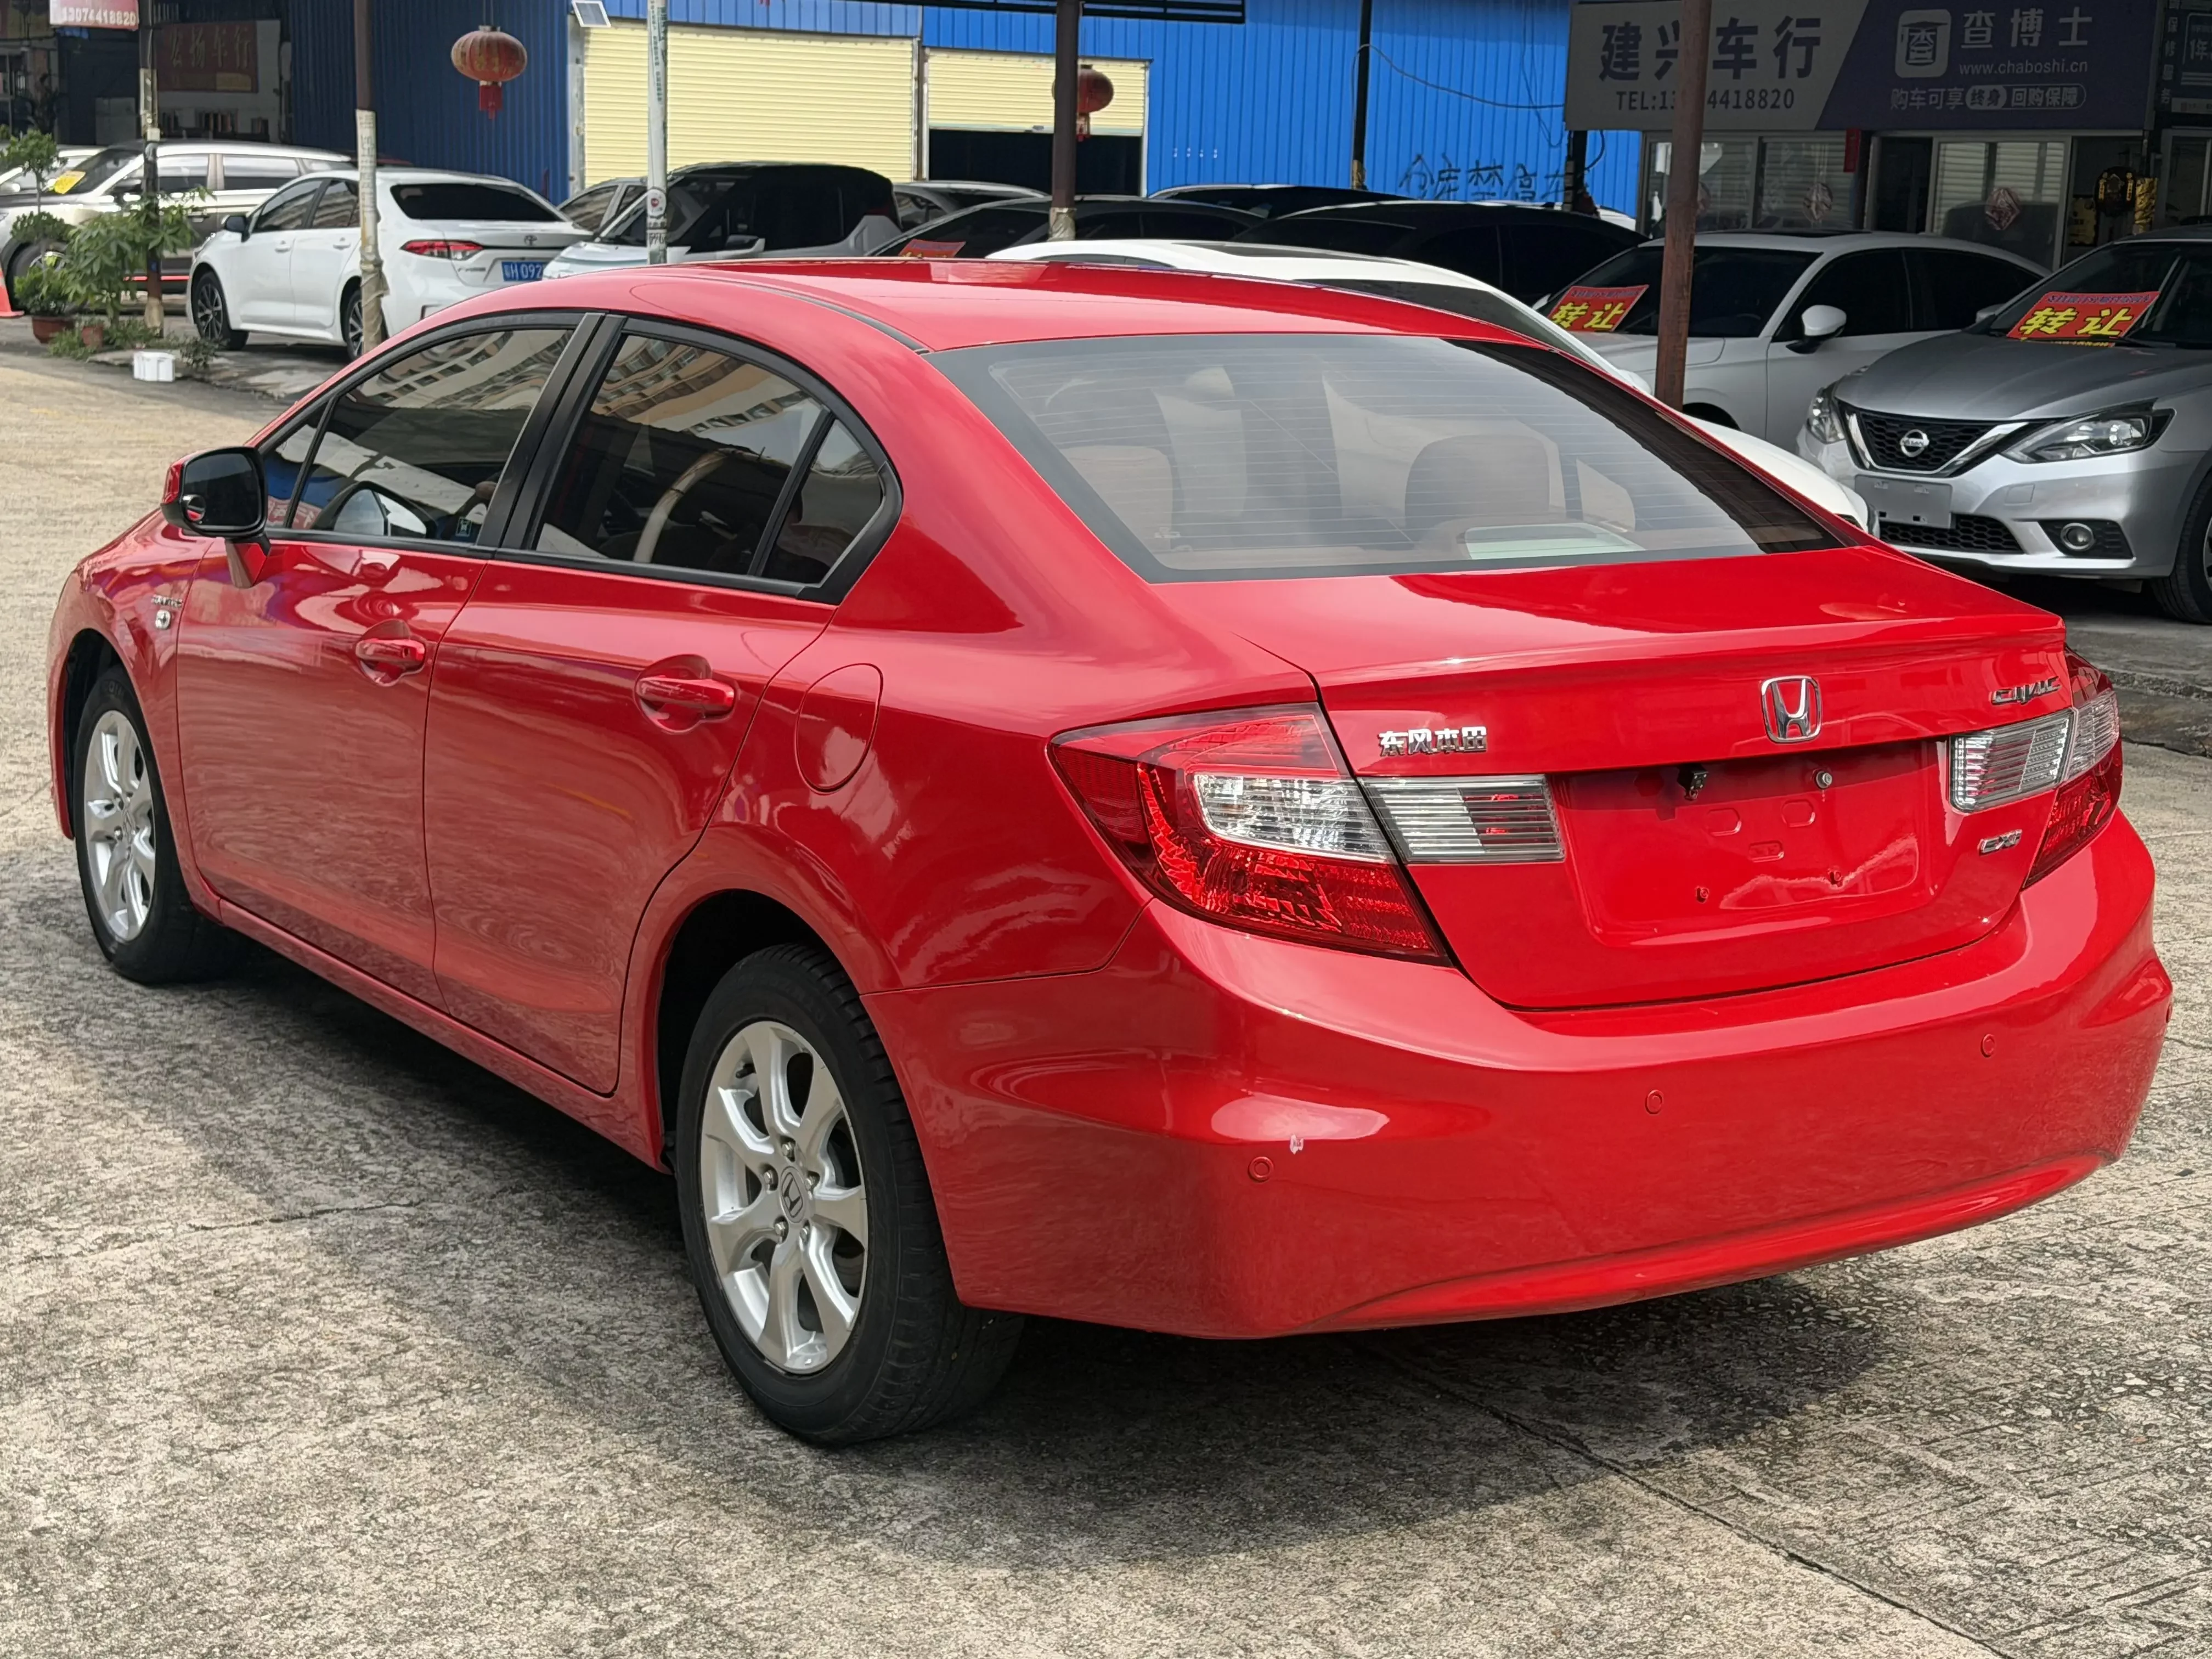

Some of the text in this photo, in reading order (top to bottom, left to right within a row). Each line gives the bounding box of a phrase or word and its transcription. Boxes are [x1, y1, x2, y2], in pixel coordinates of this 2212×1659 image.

[1961, 7, 2092, 48] 查博士
[1959, 59, 2088, 75] www.chaboshi.cn
[1616, 88, 1795, 110] TEL:14418820
[1550, 302, 1626, 329] 转让
[2019, 307, 2133, 335] 转让
[1378, 726, 1488, 757] 东风本田
